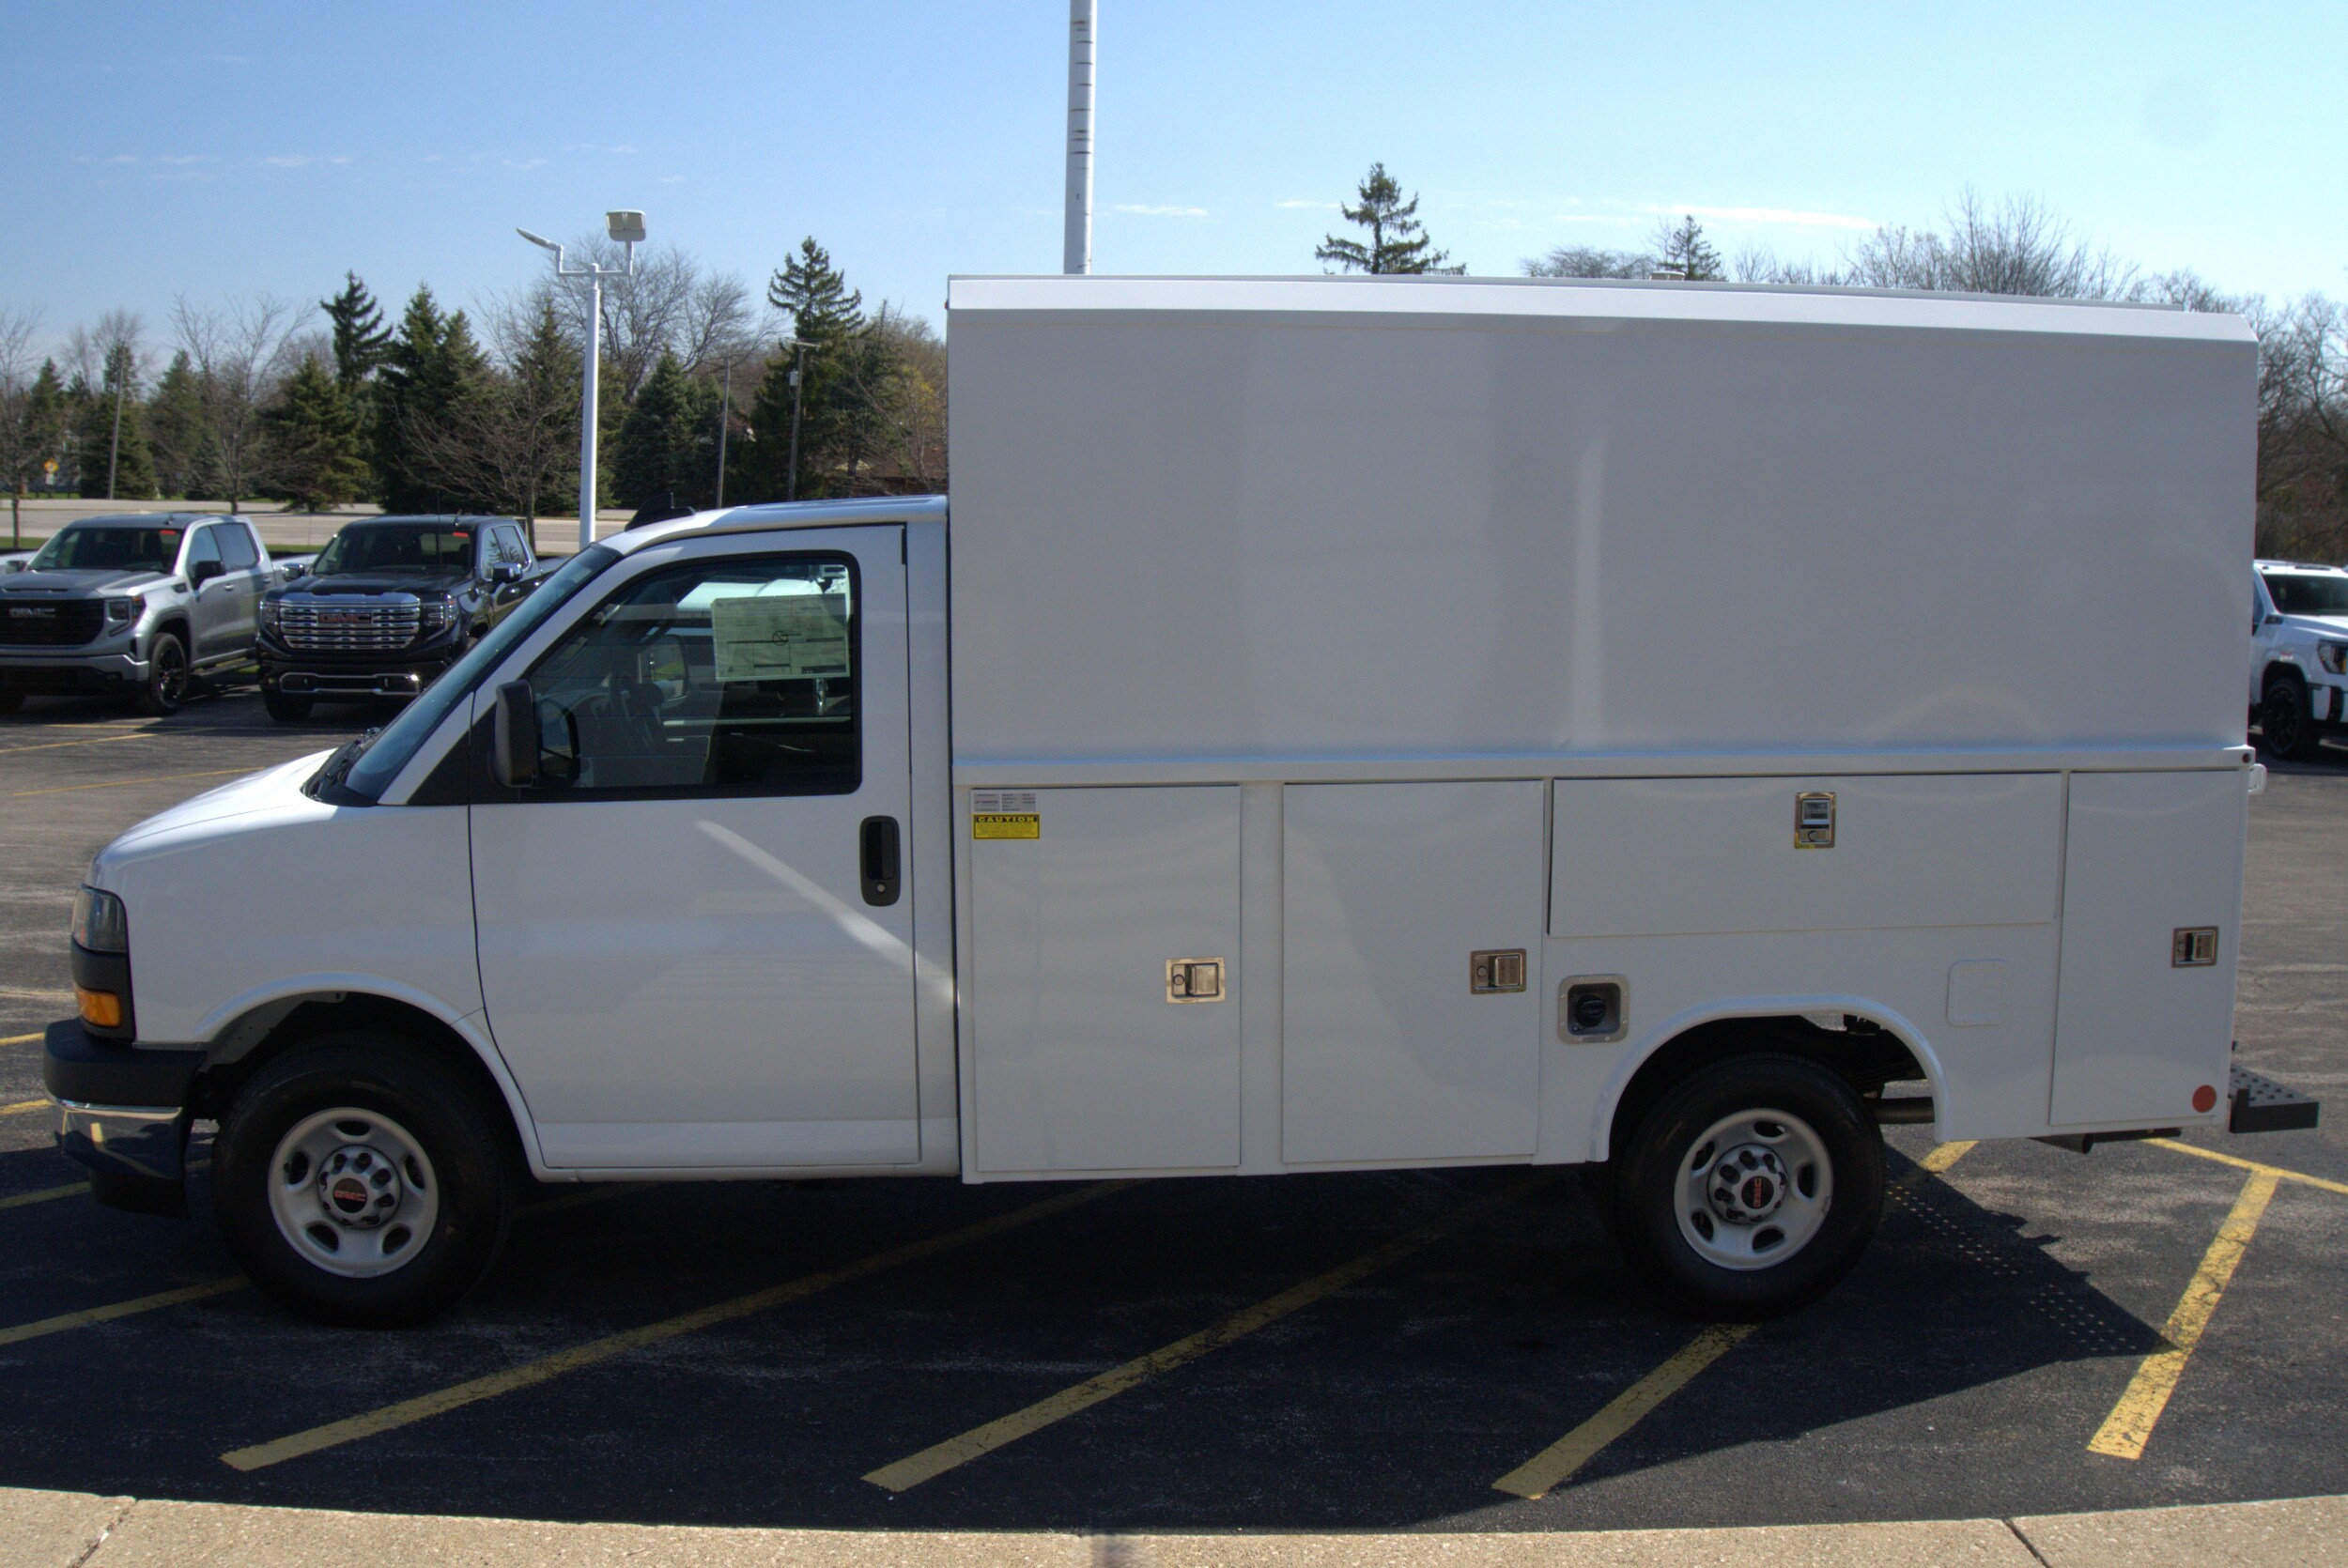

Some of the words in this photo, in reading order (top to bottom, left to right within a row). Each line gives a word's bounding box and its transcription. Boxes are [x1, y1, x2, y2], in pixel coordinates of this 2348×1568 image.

[8, 607, 55, 618] GMC
[319, 613, 371, 623] GMC
[333, 1190, 366, 1202] GMC
[1753, 1177, 1762, 1207] GMC
